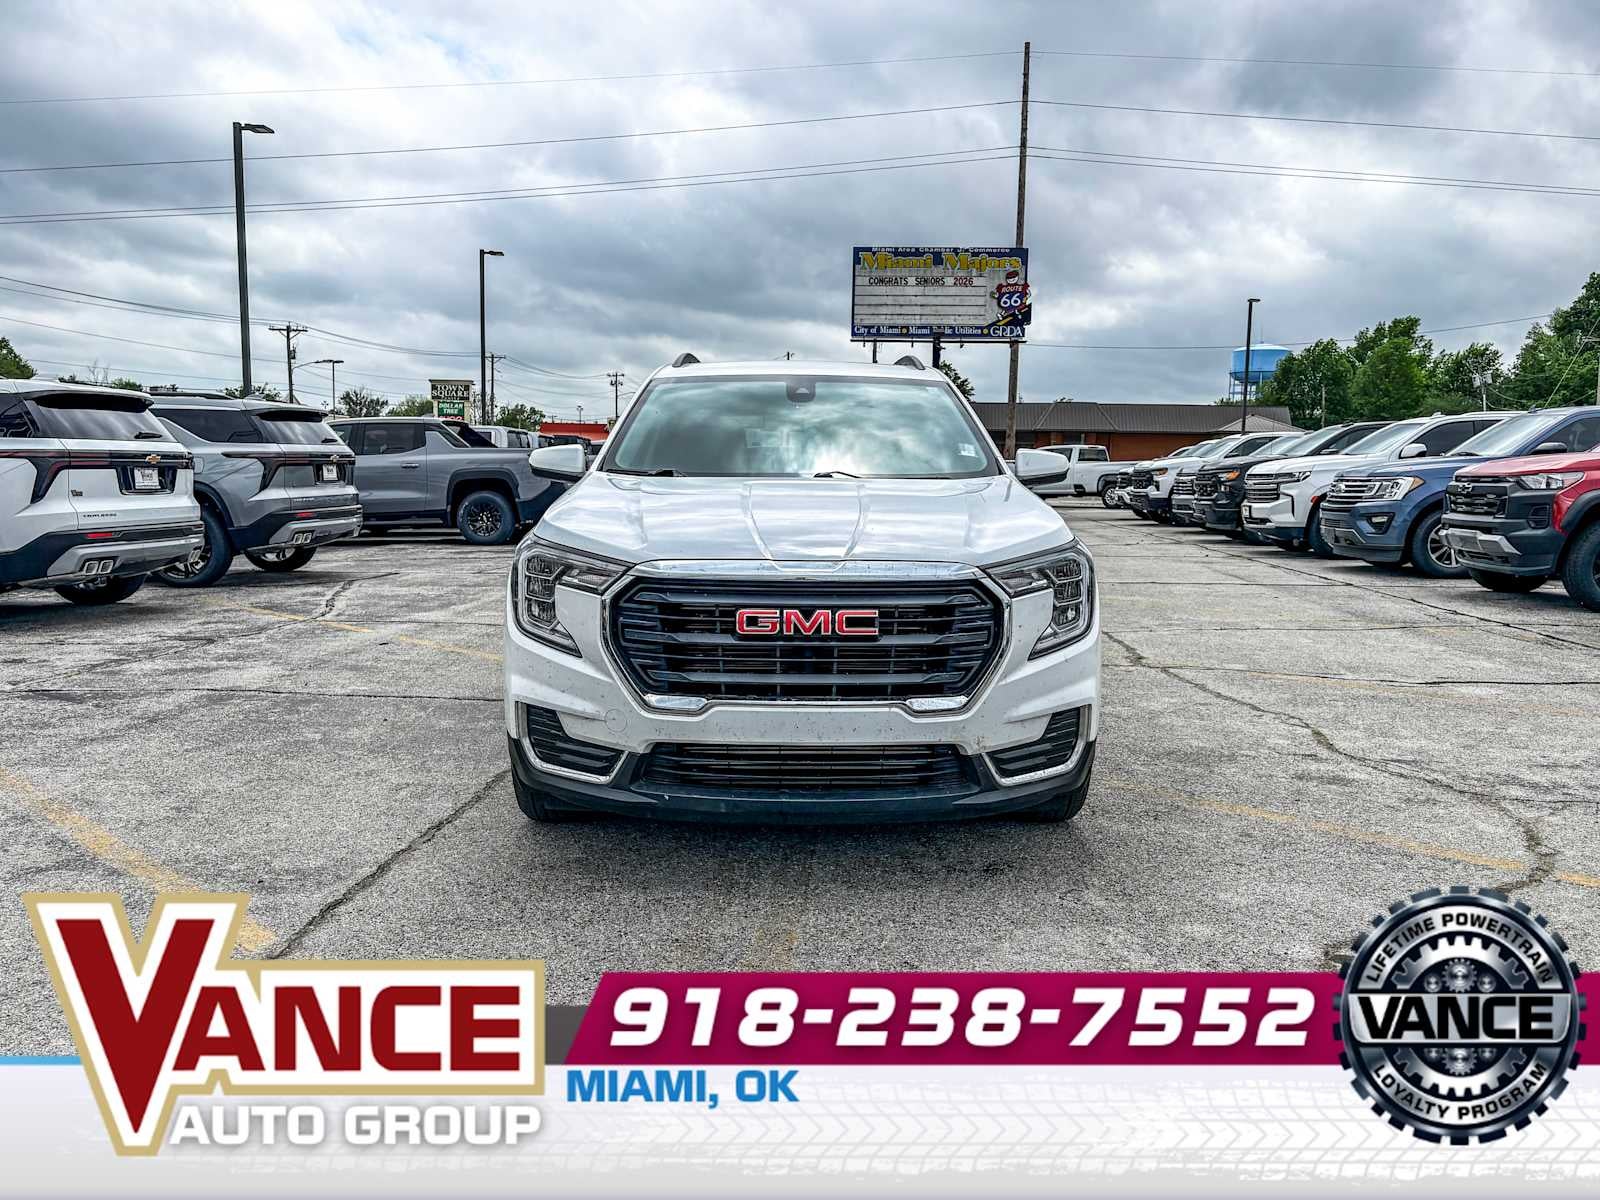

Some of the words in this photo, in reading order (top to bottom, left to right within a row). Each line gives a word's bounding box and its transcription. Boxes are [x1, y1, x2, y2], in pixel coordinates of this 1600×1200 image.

[860, 252, 932, 270] Miami
[942, 253, 1021, 272] Majors
[868, 277, 909, 287] CONGRATS
[915, 277, 946, 287] SENIORS
[953, 277, 974, 287] 2026
[1001, 285, 1023, 294] ROUTE
[1000, 293, 1021, 308] 66
[854, 325, 868, 336] City
[870, 326, 878, 334] of
[880, 326, 901, 334] Miami
[909, 326, 931, 335] Miami
[990, 325, 1023, 337] GRDA
[432, 390, 469, 398] SQUARE
[735, 608, 880, 636] GMC
